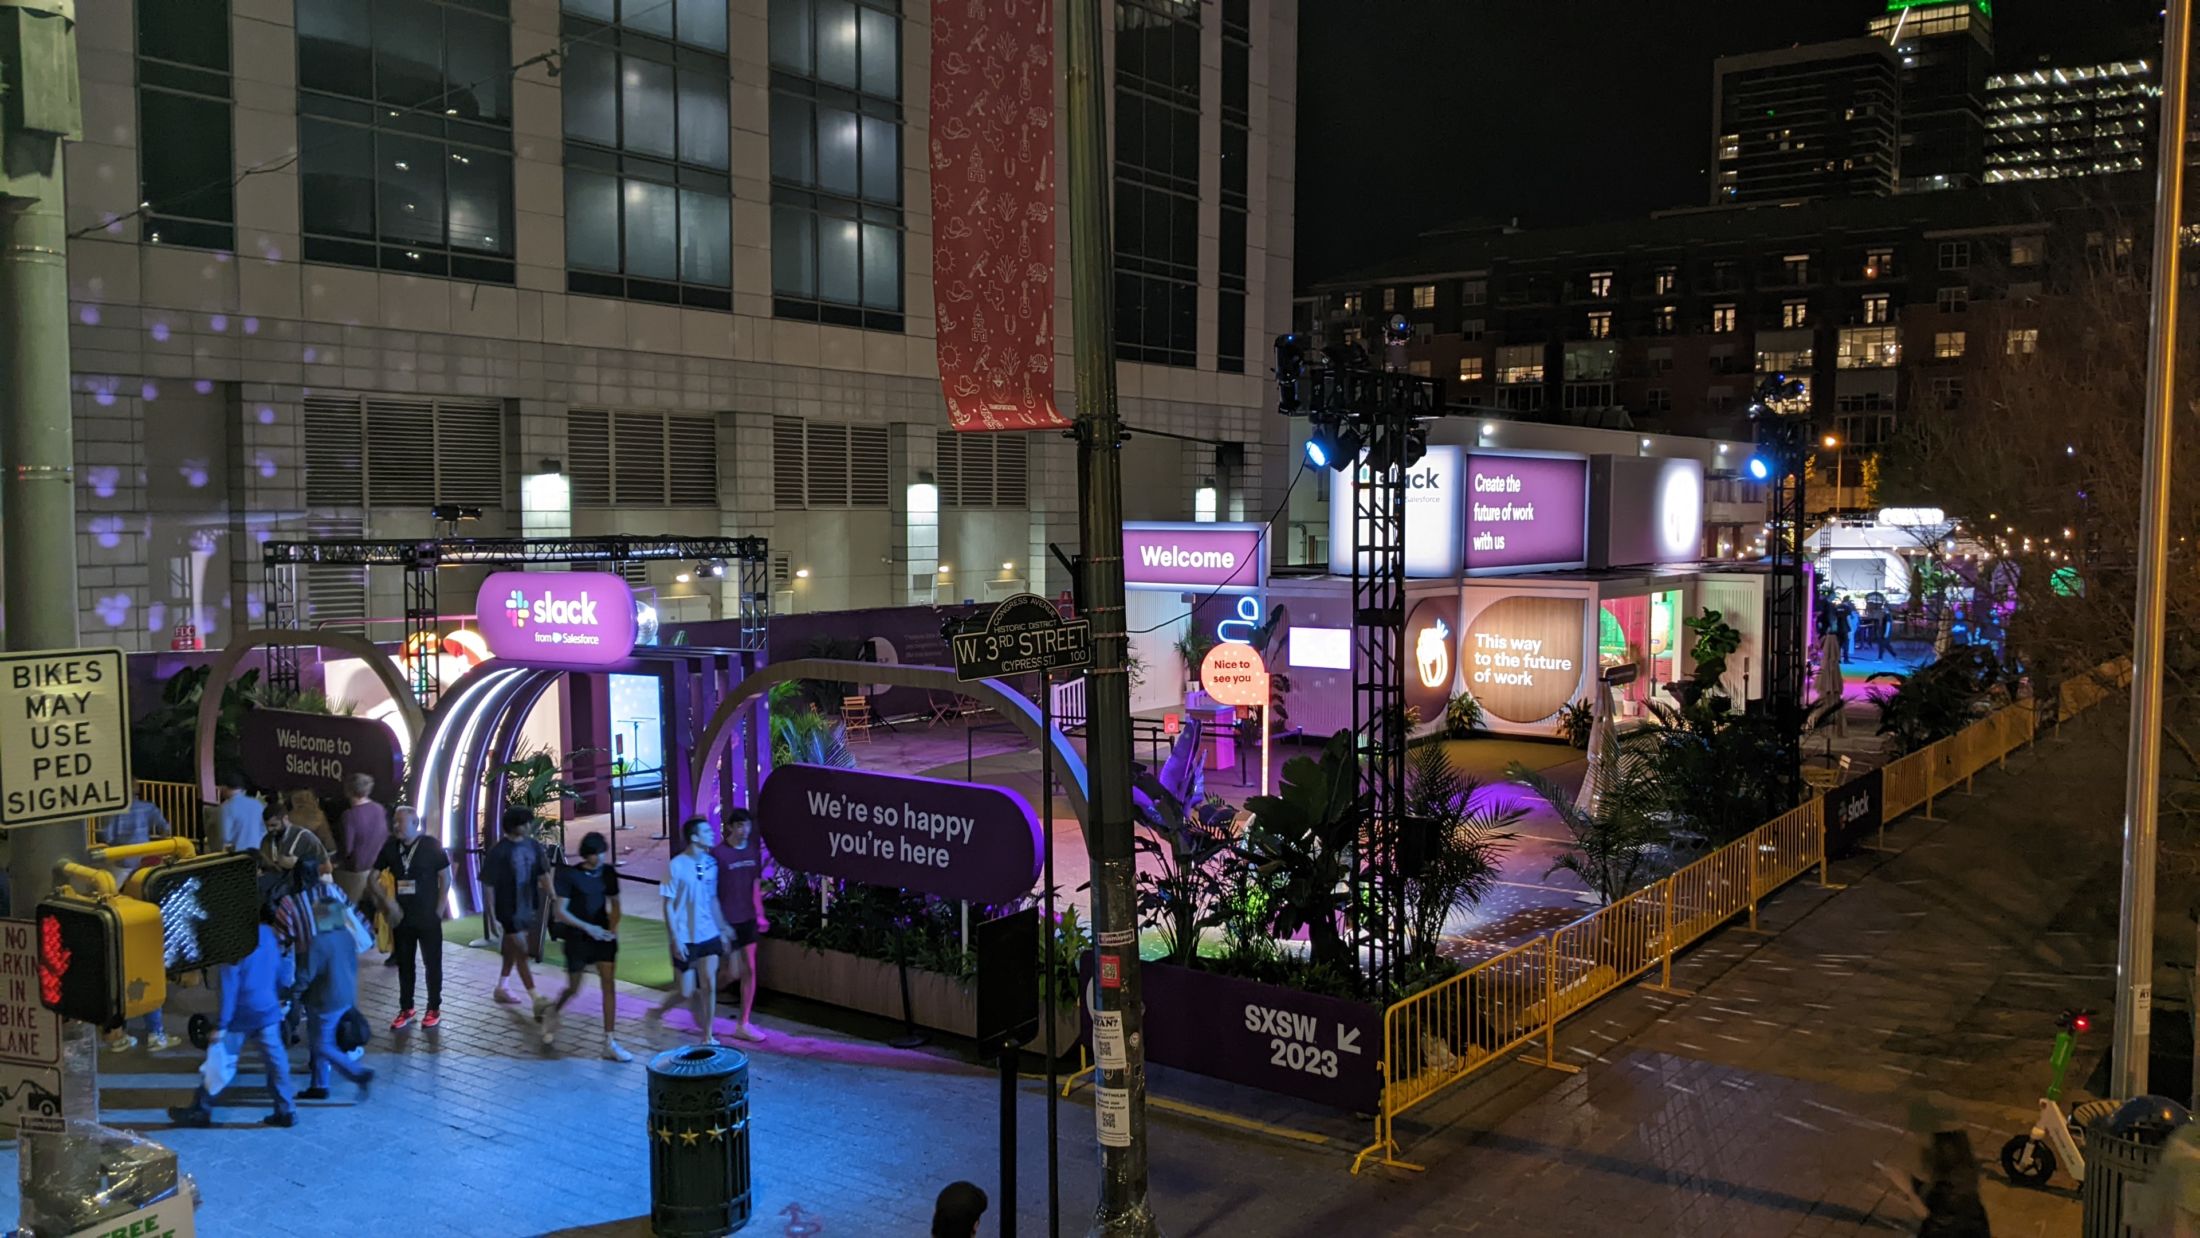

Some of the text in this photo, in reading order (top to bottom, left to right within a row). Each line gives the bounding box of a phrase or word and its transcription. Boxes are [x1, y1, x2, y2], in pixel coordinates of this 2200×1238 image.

[1475, 473, 1521, 492] Create the
[1474, 502, 1534, 521] future of work
[1473, 532, 1505, 550] with us
[1140, 545, 1234, 568] Welcome
[533, 591, 598, 624] slack
[993, 597, 1057, 626] CONGRESS AVENUE
[534, 632, 599, 644] from Salesforce
[994, 620, 1056, 634] HISTORIC DISTRICT
[956, 638, 980, 664] W.
[986, 634, 1014, 660] 3RD
[1019, 625, 1086, 656] STREET
[1070, 650, 1086, 662] 100
[1475, 633, 1542, 655] This way
[1214, 660, 1250, 669] Nice to
[1474, 652, 1572, 670] to the future
[13, 660, 102, 689] BIKES
[1233, 676, 1251, 684] you
[1474, 668, 1533, 686] of work
[26, 691, 92, 719] MAY
[31, 722, 92, 749] USE
[276, 728, 352, 756] Welcome to
[34, 753, 92, 780] PED
[286, 754, 342, 782] Slack HQ
[8, 780, 120, 814] SIGNAL
[1848, 790, 1868, 822] slack
[807, 790, 974, 844] We're so happy
[829, 831, 950, 868] you're here
[5, 926, 27, 950] NO
[10, 979, 26, 1002] IN
[0, 1004, 38, 1030] BIKE
[1244, 1004, 1317, 1044] SXSW
[1270, 1038, 1338, 1078] 2023
